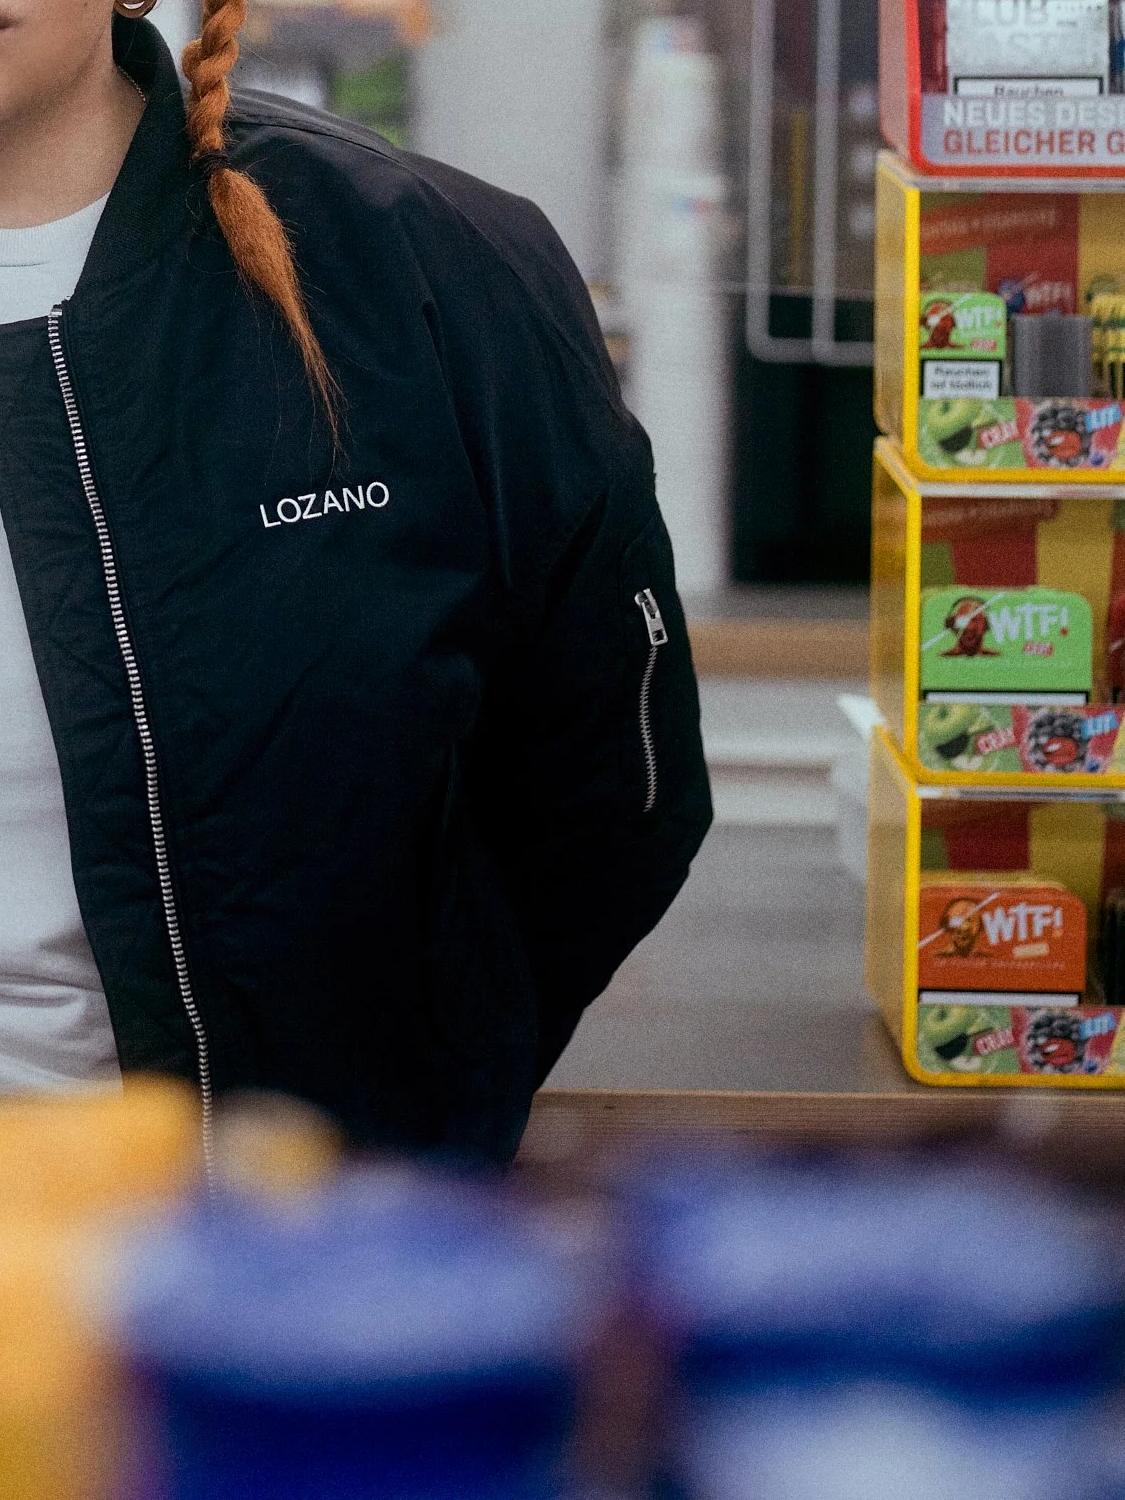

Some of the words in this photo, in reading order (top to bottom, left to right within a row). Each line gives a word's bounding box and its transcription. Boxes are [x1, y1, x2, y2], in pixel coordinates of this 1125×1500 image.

[943, 100, 1047, 128] NEUES
[943, 129, 1096, 156] GLEICHER
[955, 305, 1003, 331] WTF!
[259, 481, 390, 528] LOZANO
[988, 602, 1070, 646] WTF!
[982, 901, 1064, 947] WTF!
